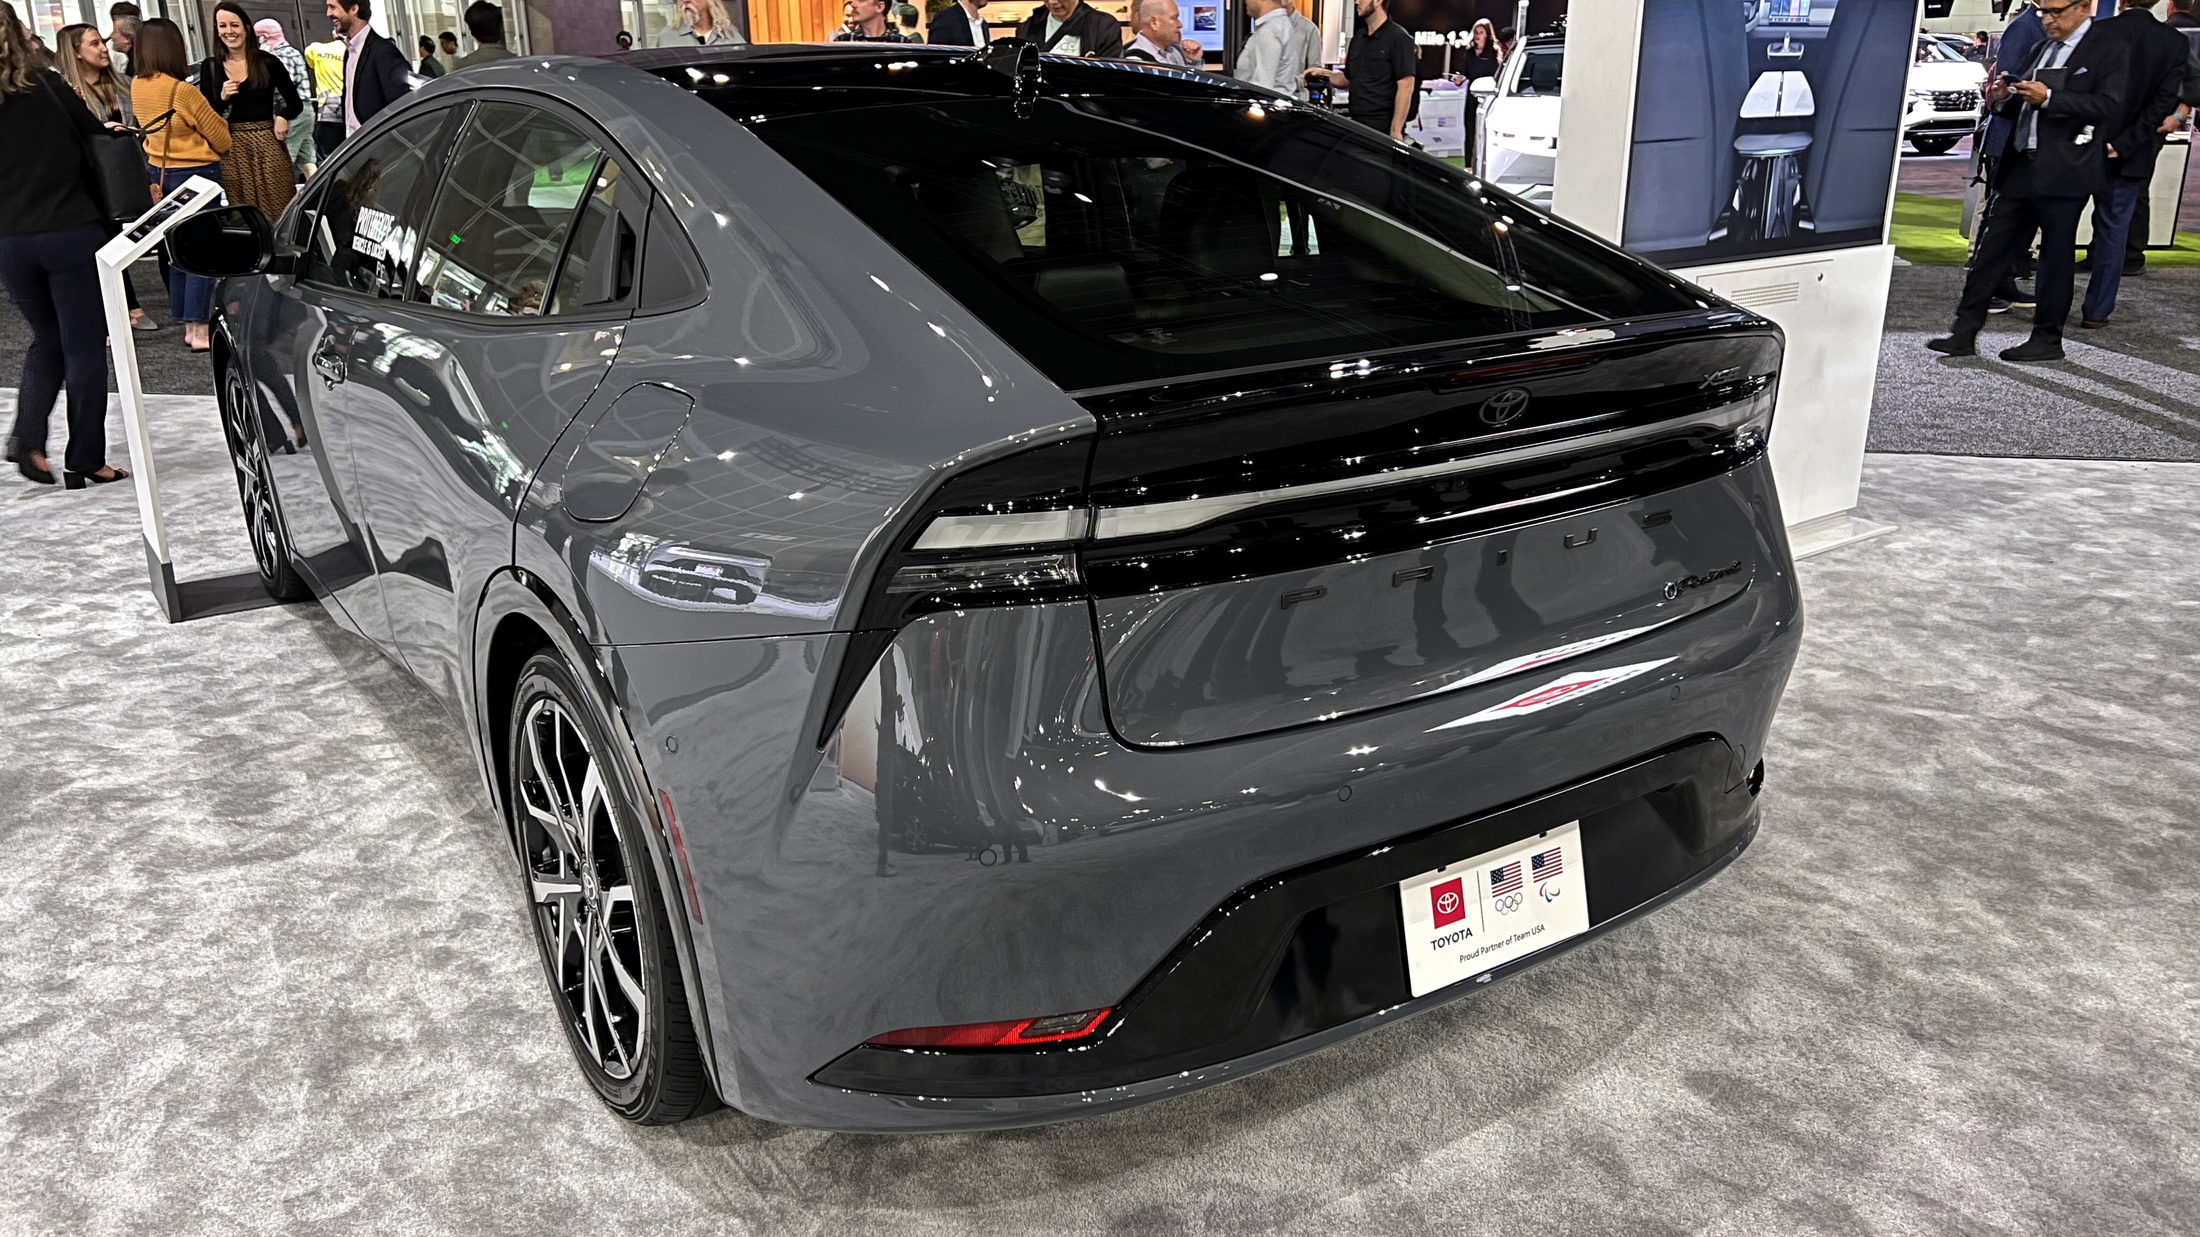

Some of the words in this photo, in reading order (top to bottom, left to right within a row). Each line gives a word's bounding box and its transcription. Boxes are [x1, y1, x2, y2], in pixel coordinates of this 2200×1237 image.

[1281, 509, 1672, 610] PRIUS
[1430, 927, 1473, 951] TOYOTA
[1459, 947, 1480, 963] Proud
[1480, 940, 1505, 956] Partner
[1505, 937, 1514, 948] of
[1513, 930, 1532, 943] Team
[1531, 924, 1546, 937] USA
